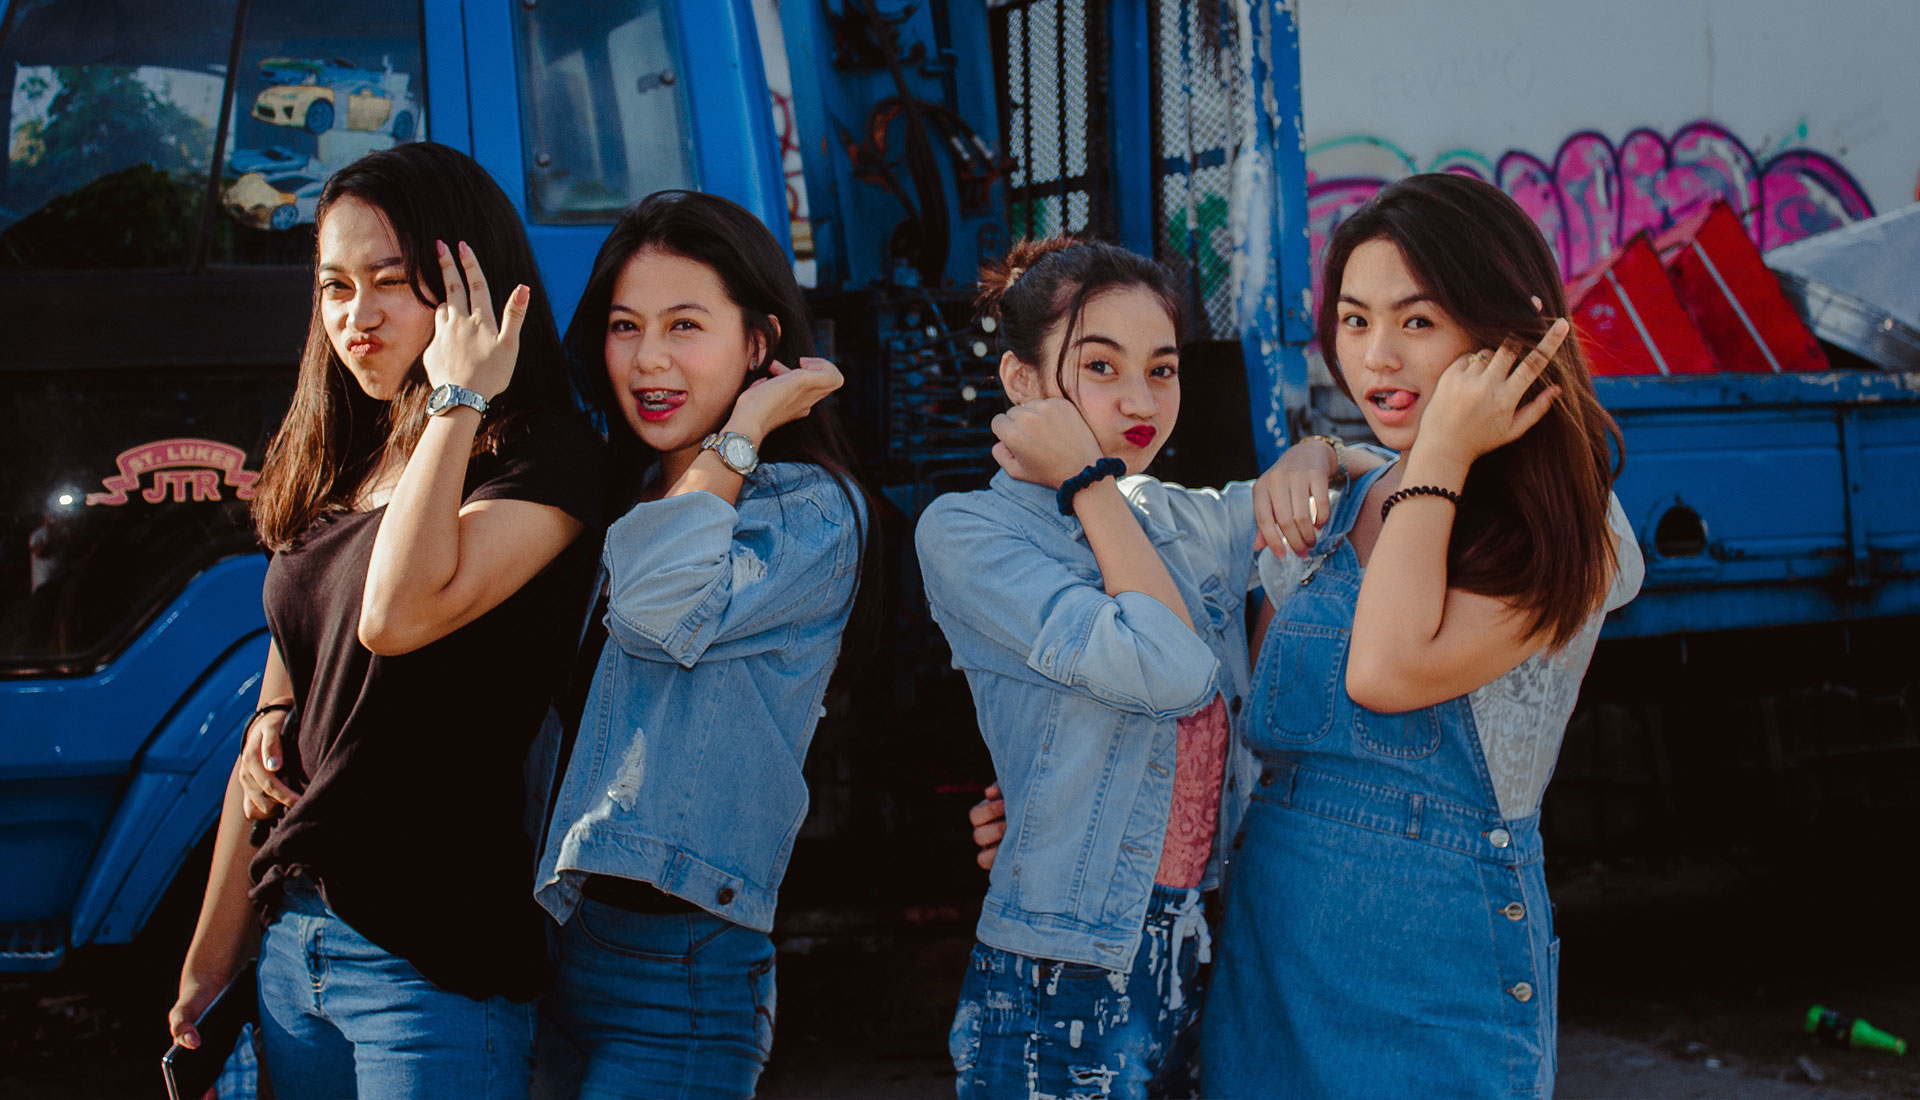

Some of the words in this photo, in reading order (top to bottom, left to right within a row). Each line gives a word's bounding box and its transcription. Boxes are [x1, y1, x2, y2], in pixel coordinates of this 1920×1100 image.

[128, 452, 163, 472] ST.
[167, 445, 236, 469] LUKES
[142, 470, 221, 503] JTR
